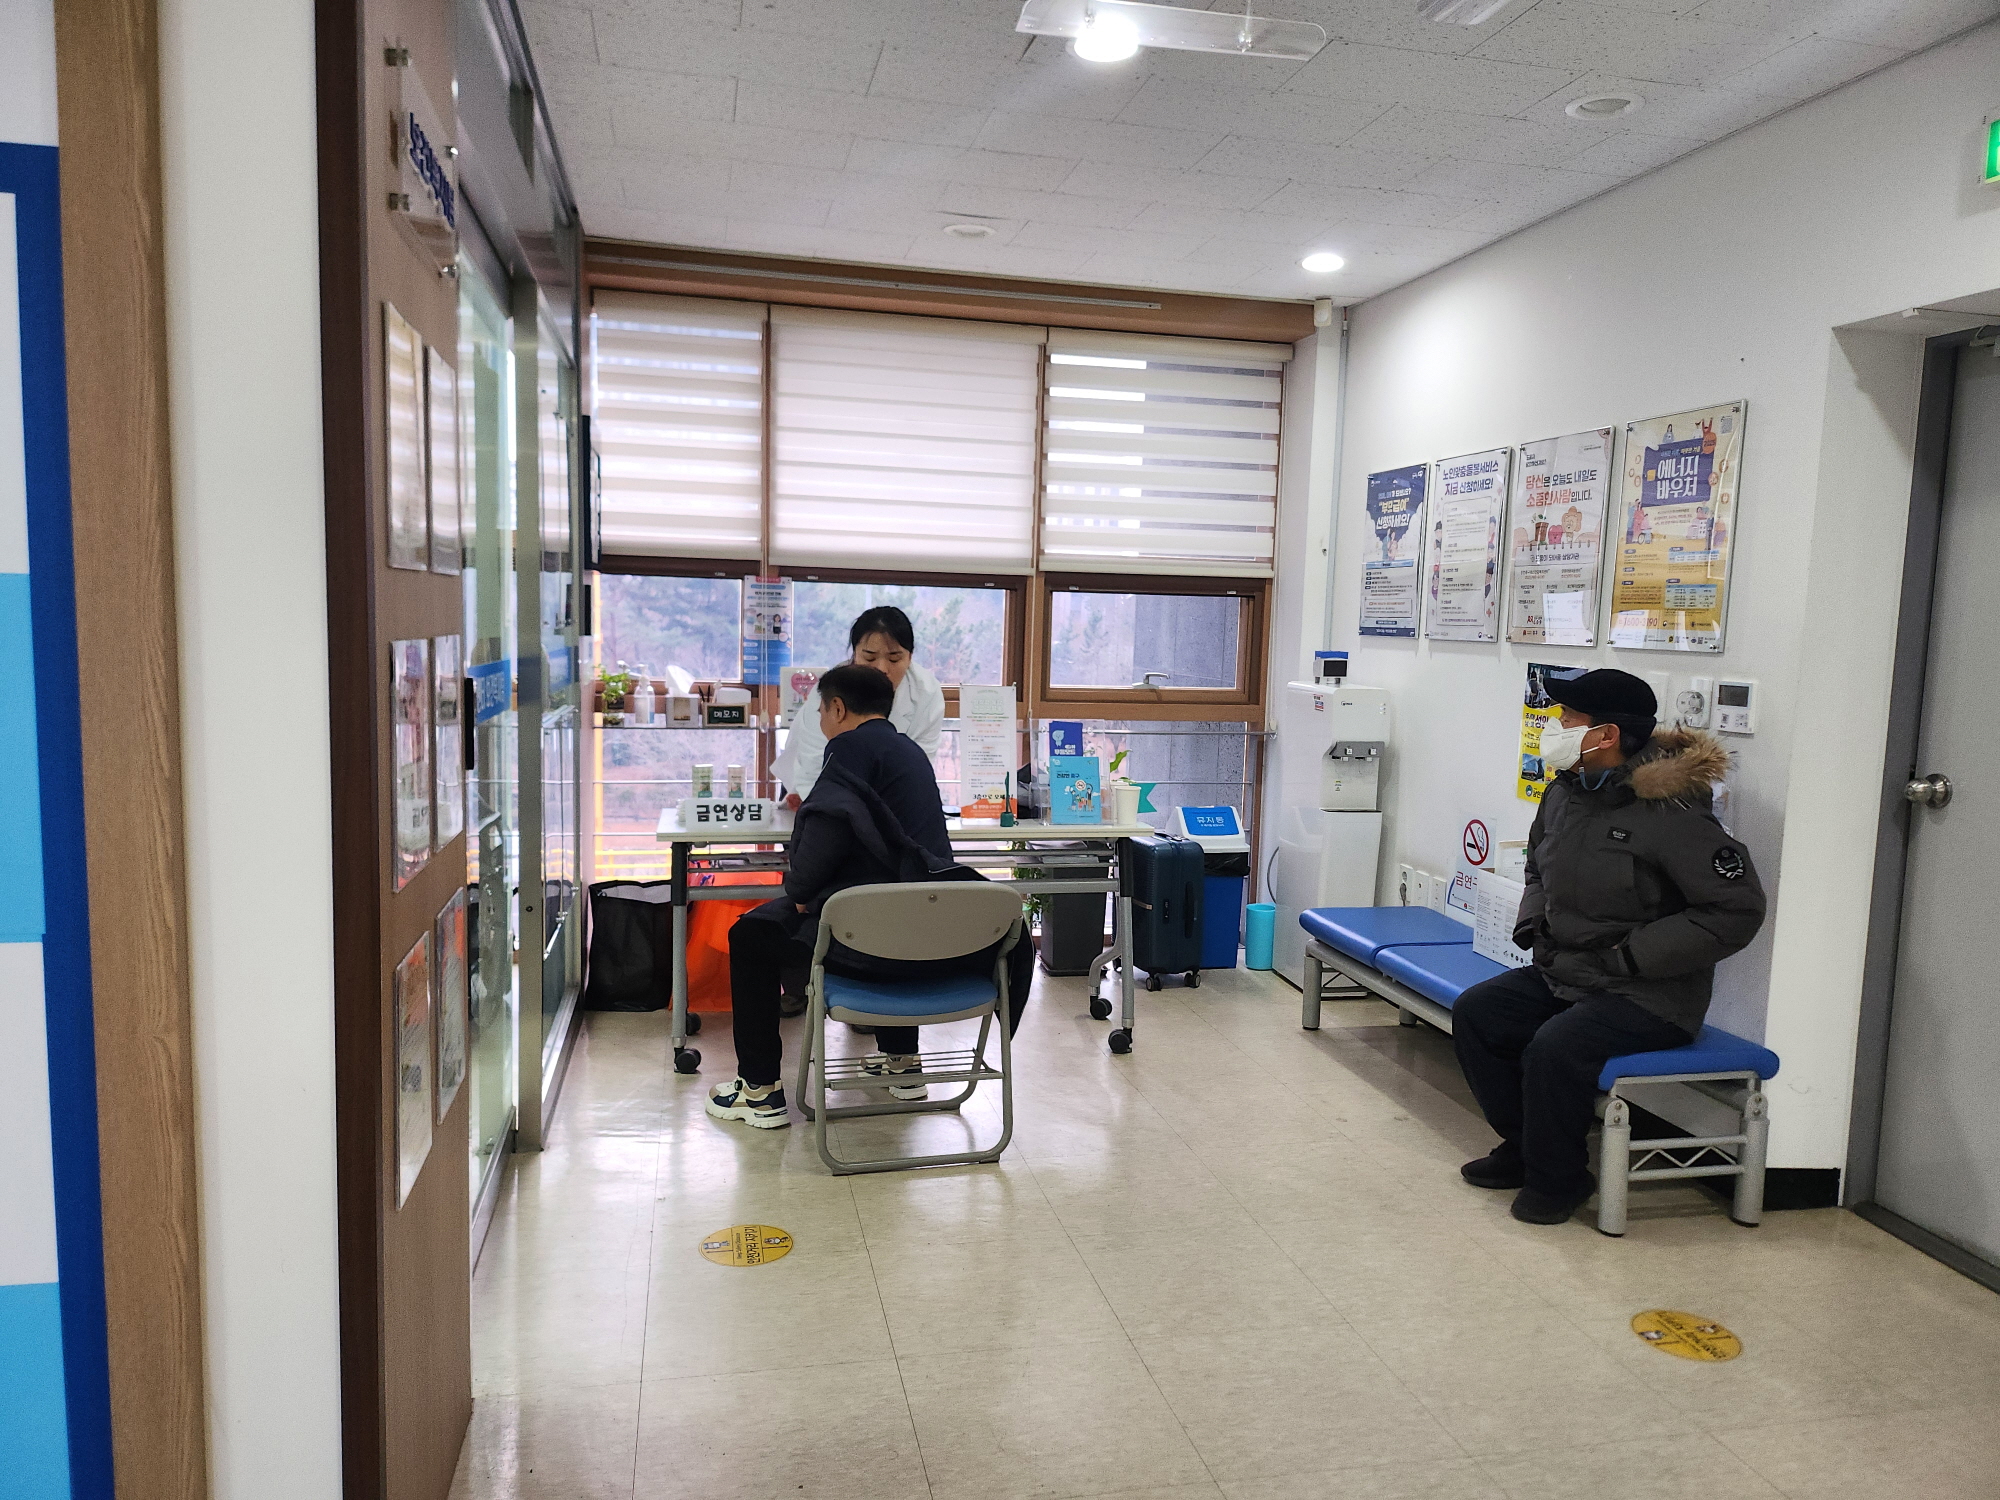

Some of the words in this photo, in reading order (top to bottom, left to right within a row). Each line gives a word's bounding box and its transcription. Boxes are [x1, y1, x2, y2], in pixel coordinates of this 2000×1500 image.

[1442, 460, 1498, 480] 노인맞춤돌봄서비스
[1657, 455, 1699, 479] 에너지
[1445, 481, 1458, 495] 지금
[1460, 477, 1493, 494] 신청하세요!
[1526, 474, 1550, 489] 당신은
[1552, 473, 1573, 486] 오늘도
[1574, 469, 1597, 483] 내일도
[1657, 477, 1698, 500] 바우처
[1376, 513, 1410, 530] 신청하세요!
[713, 710, 739, 718] 메모지
[696, 803, 762, 822] 금연상담
[1196, 816, 1224, 824] 휴지통
[744, 1226, 758, 1241] 지키기
